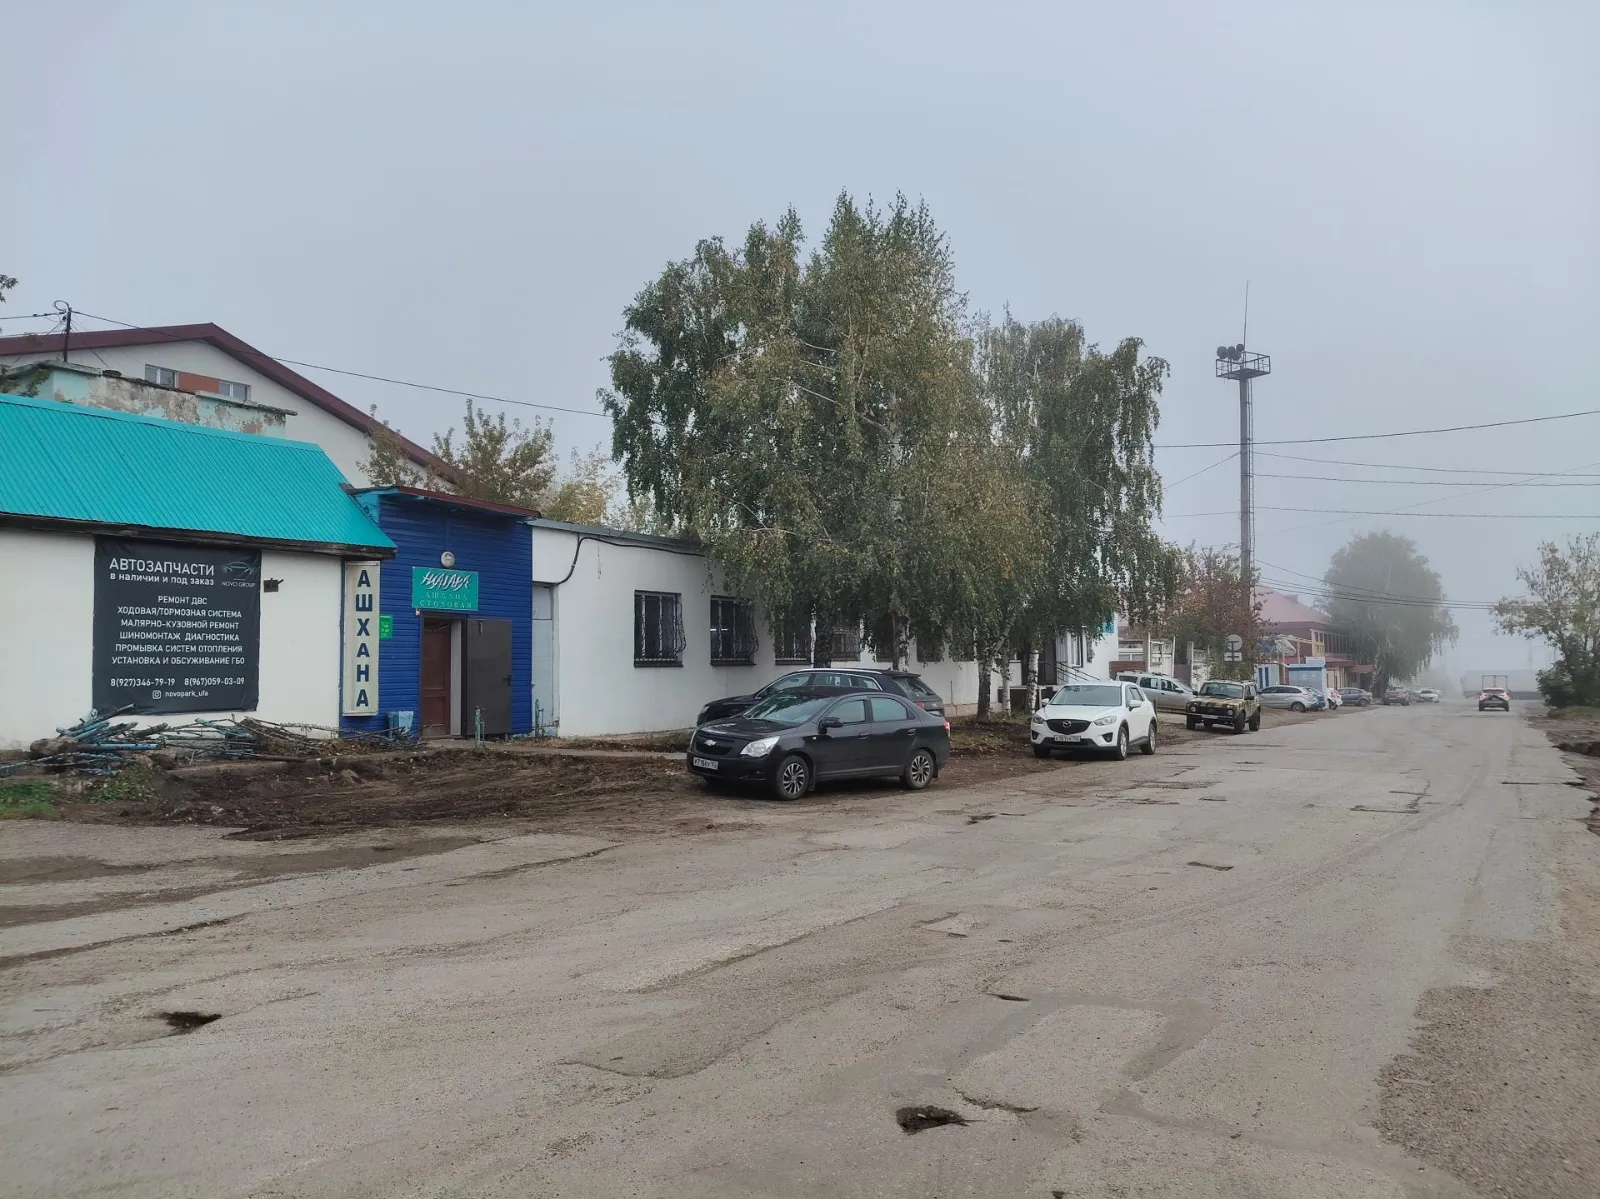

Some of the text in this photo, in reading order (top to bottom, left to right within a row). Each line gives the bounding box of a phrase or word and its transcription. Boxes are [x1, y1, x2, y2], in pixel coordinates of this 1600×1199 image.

[109, 557, 215, 576] АВТОЗАПЧАСТИ
[118, 573, 160, 583] наличии
[170, 576, 188, 586] под
[189, 577, 215, 586] заказ
[157, 595, 208, 605] РЕМОНТ ДВС
[419, 599, 472, 609] СТОЛОВАЯ
[117, 605, 242, 618] ХОДОВАЯ/ТОРМОЗНАЯ СИСТЕМА
[120, 618, 240, 630] МАЛЯРНО-КУЗОВНОЙ РЕМОНТ
[119, 631, 240, 642] ШИНОМОНТАЖ ДИАГНОСТИКА
[355, 569, 373, 708] АШХАНА
[115, 643, 243, 653] ПРОМЫВКА СИСТЕМ ОТОПЛЕНИЯ
[111, 656, 245, 665] УСТАНОВКА И ОБСУЖИВАНИЕ ГБО
[110, 676, 245, 688] 8(927)346-79-19 8(967)059-03-09
[165, 689, 209, 699] novopark_ufa
